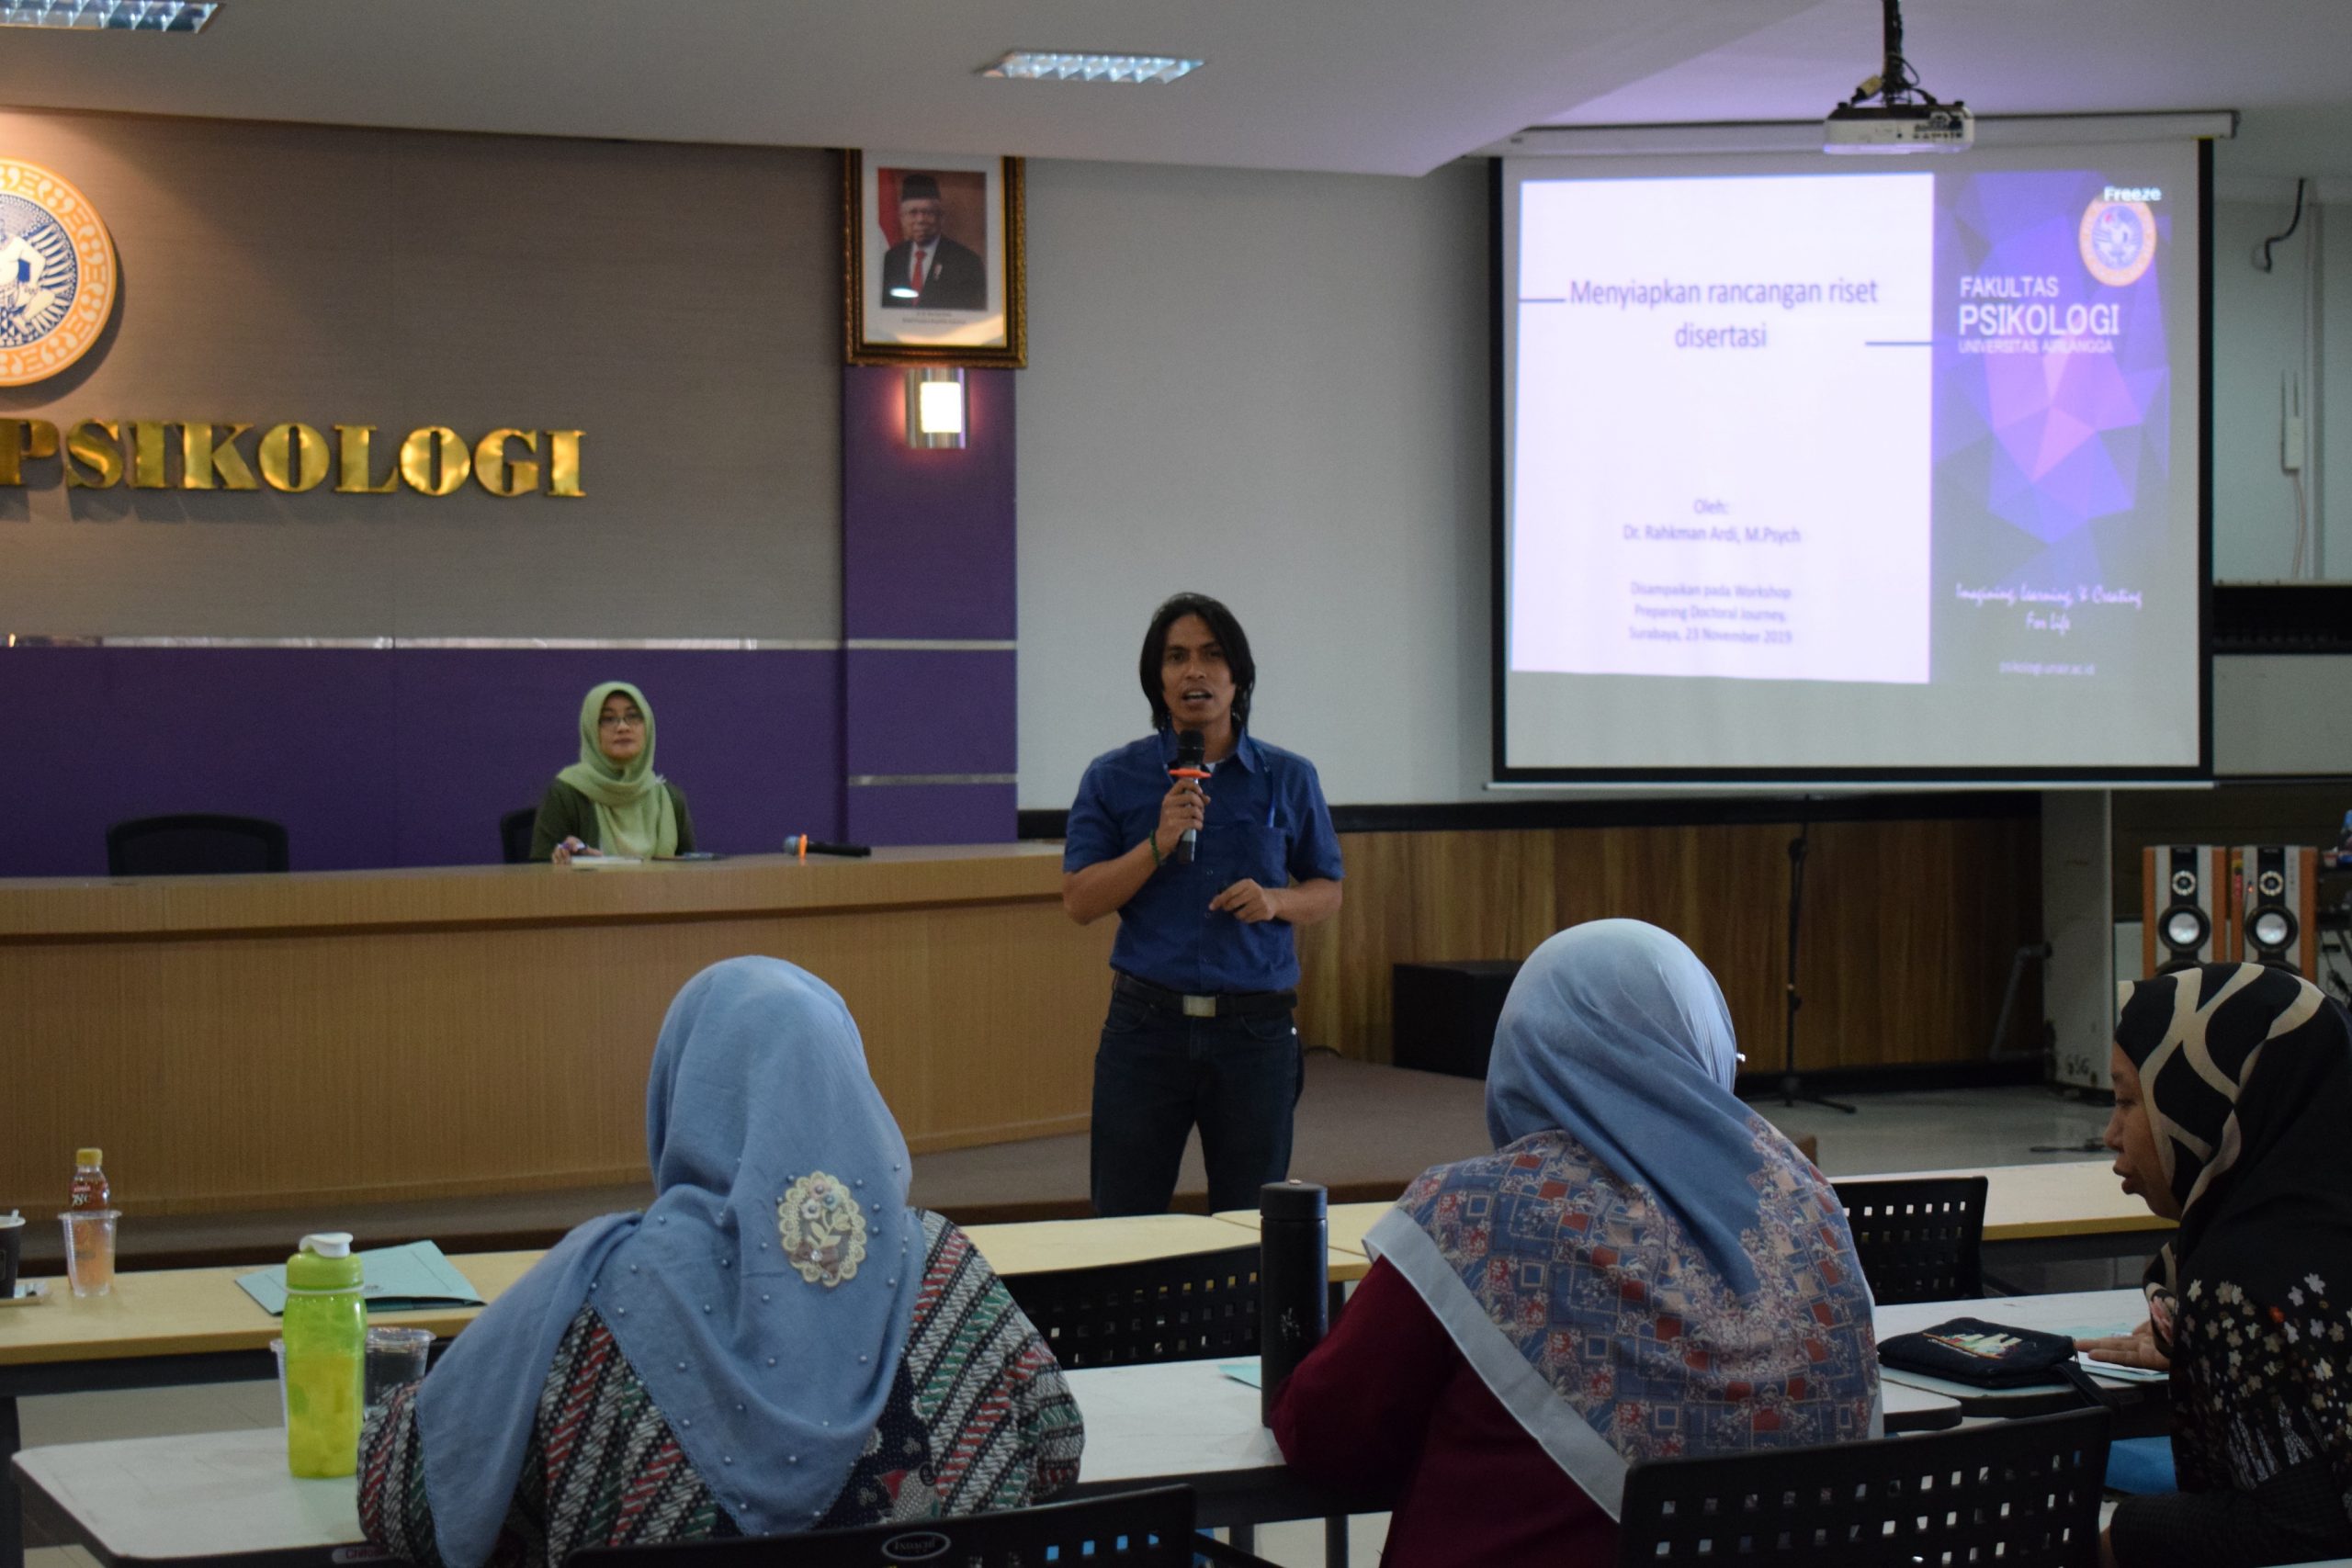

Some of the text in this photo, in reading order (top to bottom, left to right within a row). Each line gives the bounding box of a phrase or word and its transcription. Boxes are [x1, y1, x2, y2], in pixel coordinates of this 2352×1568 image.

[2104, 186, 2162, 201] Freeze
[1570, 277, 1878, 310] Menyiapkan rancangan riset
[1960, 276, 2059, 298] FAKULTAS
[1959, 304, 2120, 335] PSIKOLOGI
[1675, 322, 1766, 348] disertasi
[0, 418, 588, 497] PSIKOLOGI
[1693, 499, 1729, 514] Oleh:
